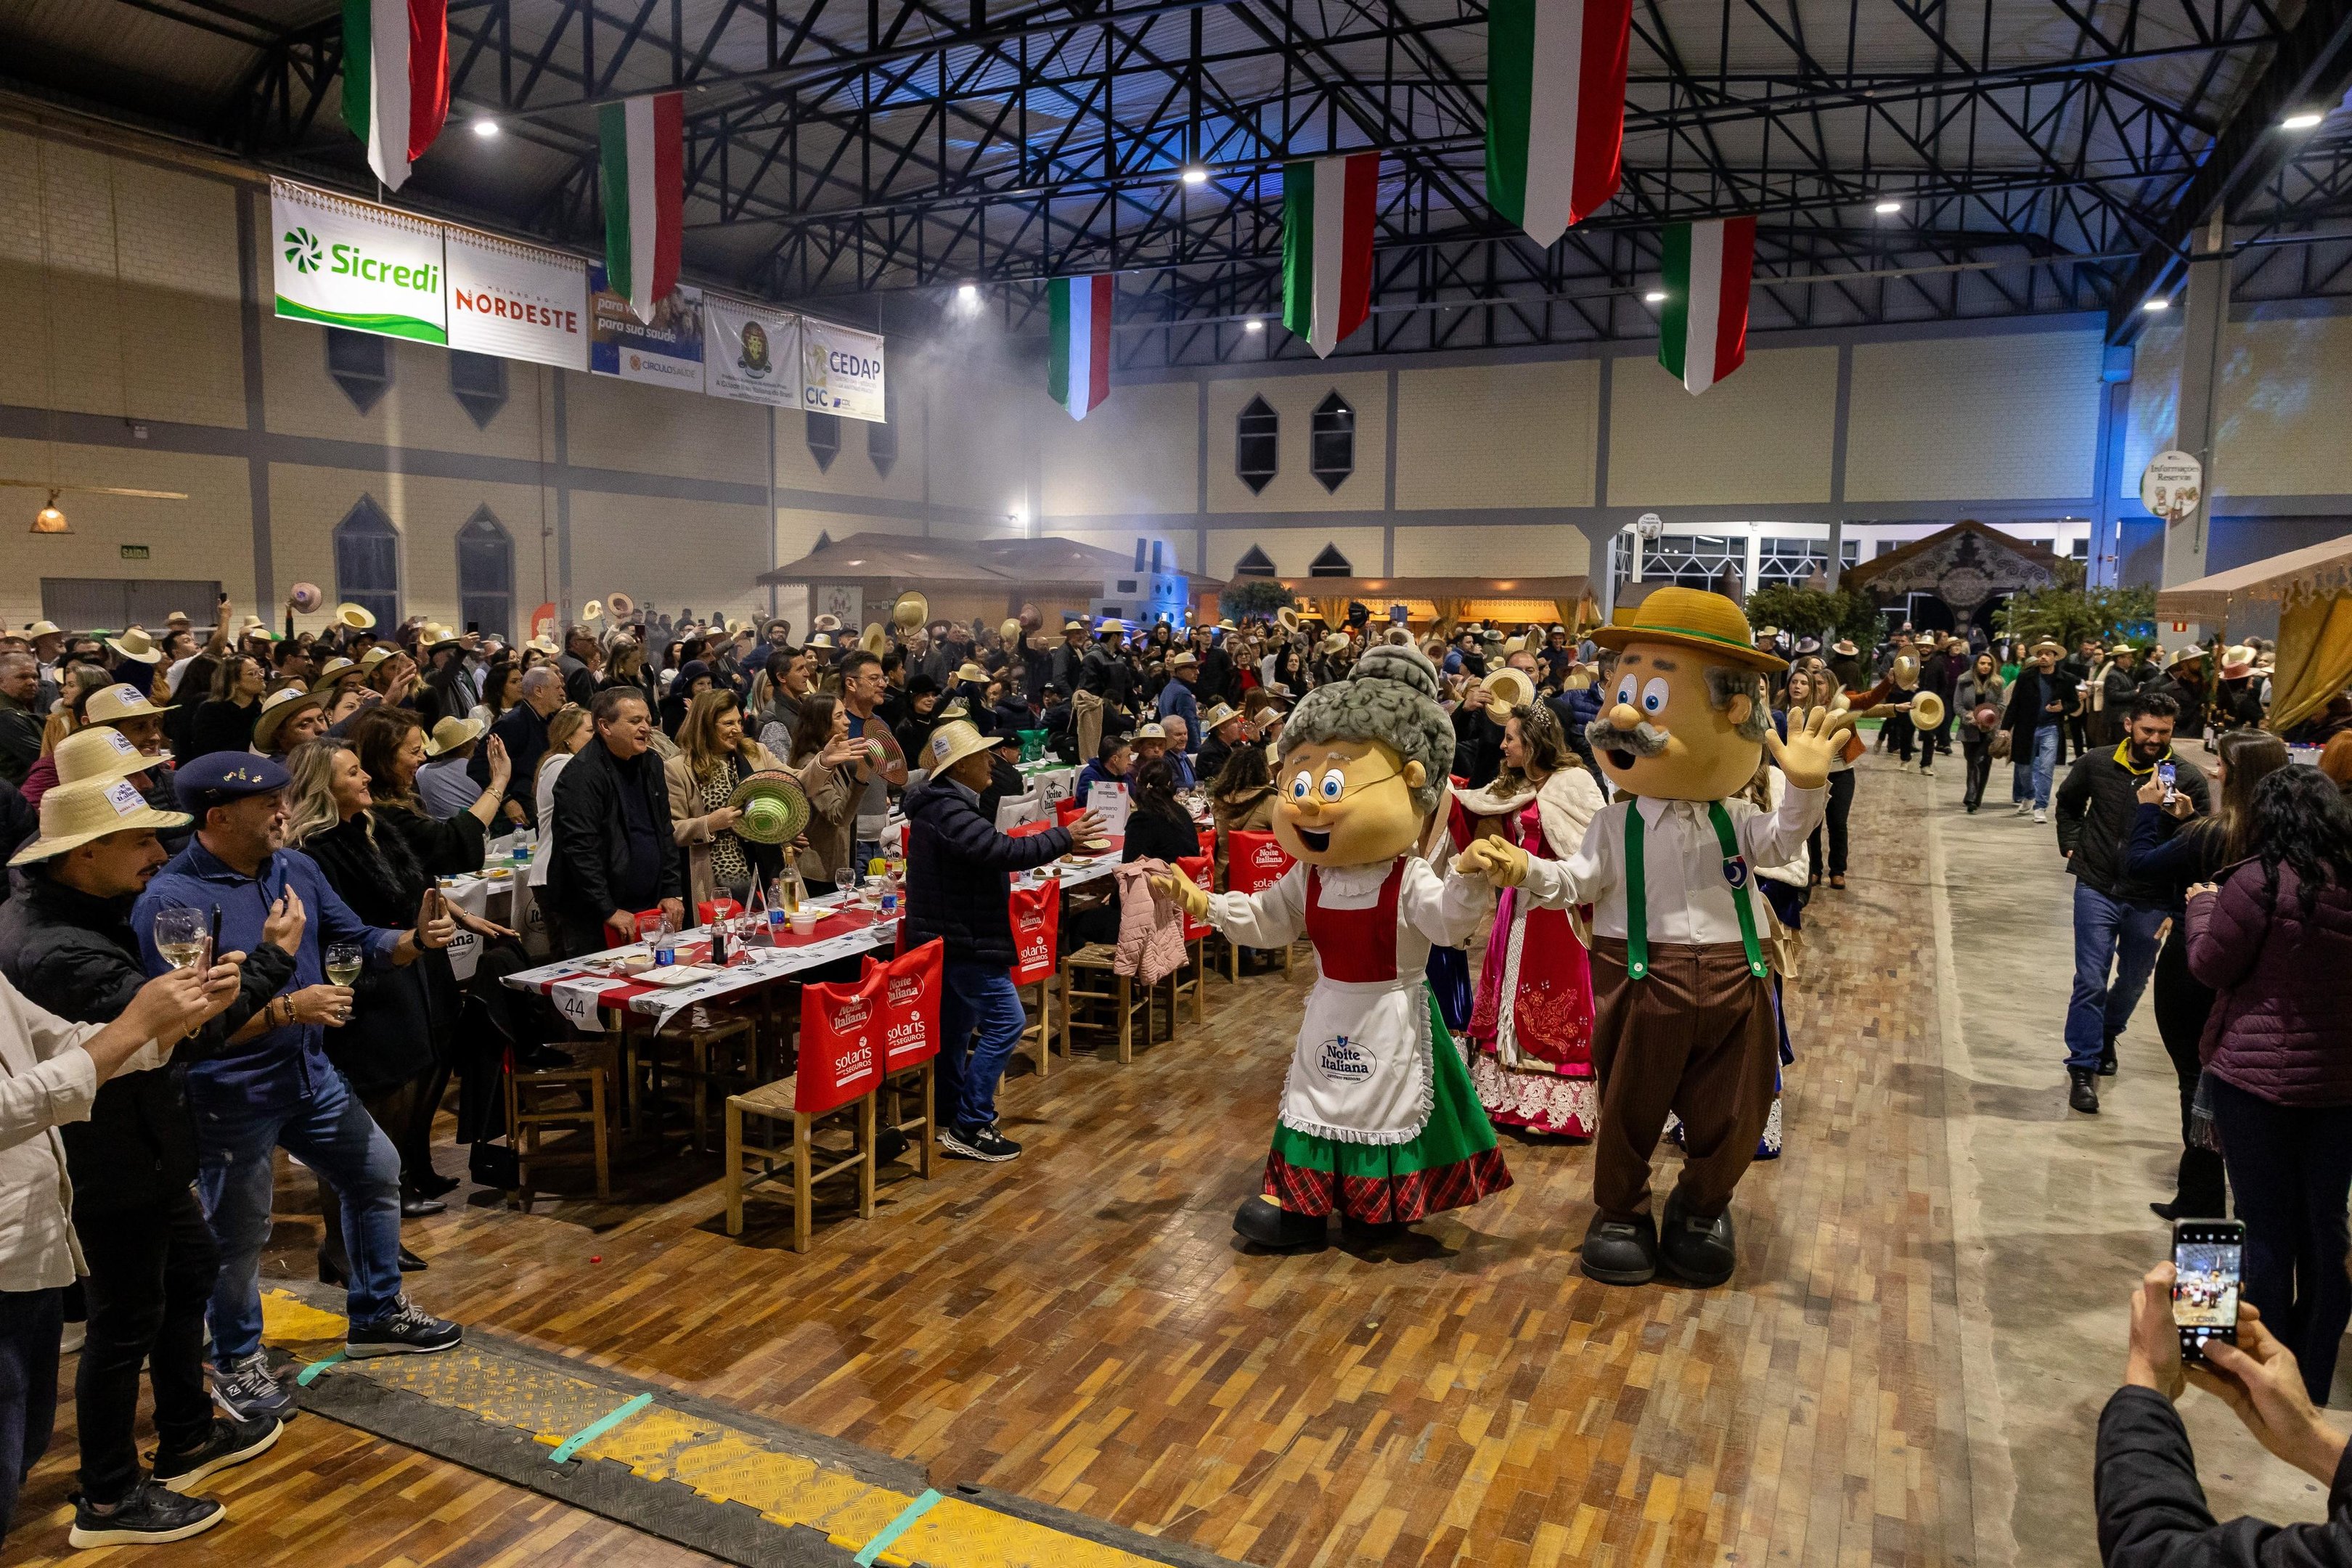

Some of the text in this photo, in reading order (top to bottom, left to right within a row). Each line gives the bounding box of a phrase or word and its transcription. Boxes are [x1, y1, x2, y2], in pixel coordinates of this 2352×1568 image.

[331, 243, 438, 293] Sicredi
[456, 288, 578, 334] NORDESTE
[597, 298, 624, 311] para
[597, 317, 624, 331] para
[625, 323, 644, 336] sua
[830, 351, 881, 380] CEDAP
[806, 387, 828, 407] CIC
[1046, 790, 1062, 799] Noite
[1021, 944, 1048, 960] solaris
[1026, 954, 1048, 964] SEGUROS
[565, 998, 585, 1018] 44
[834, 1011, 867, 1029] Italiana
[887, 1021, 926, 1042] solaris
[896, 1032, 926, 1046] SEGUROS
[836, 1047, 872, 1071] solaris
[1326, 1045, 1360, 1061] Noite
[845, 1058, 872, 1074] SEGUROS
[1321, 1055, 1369, 1074] Italiana
